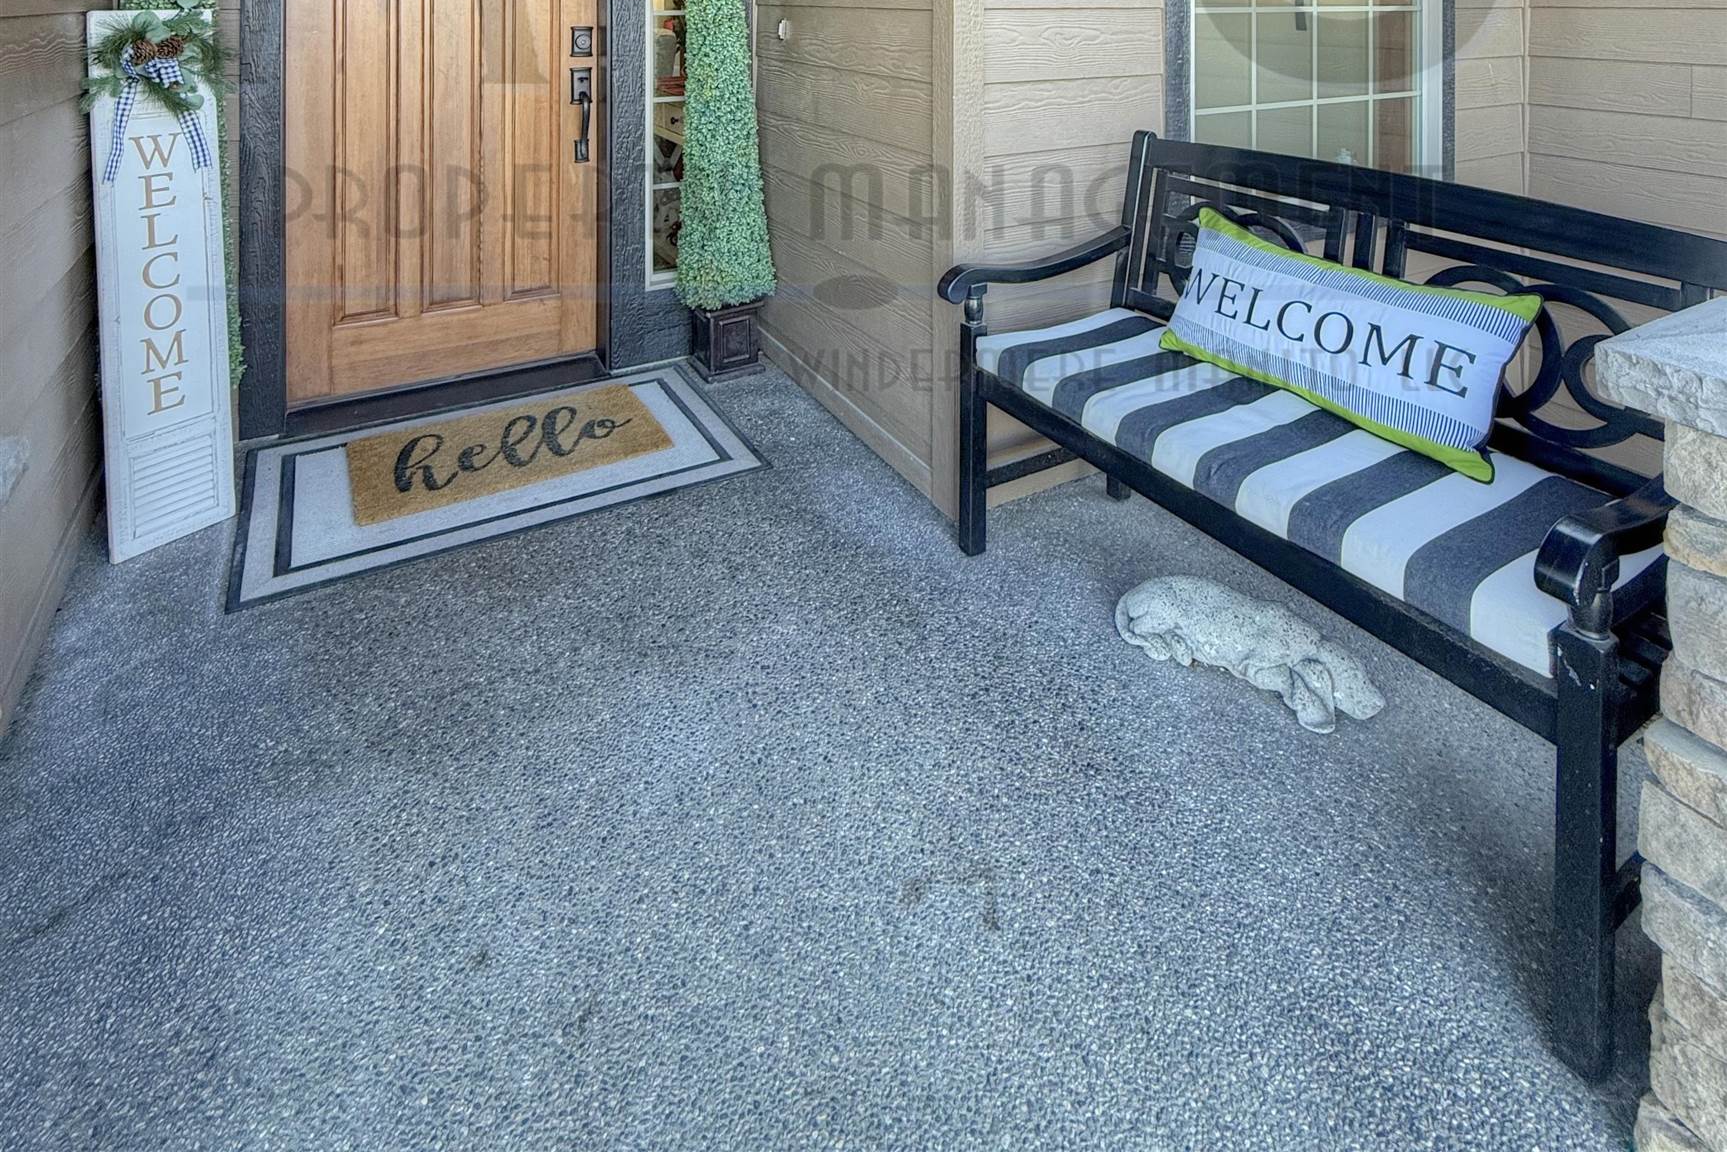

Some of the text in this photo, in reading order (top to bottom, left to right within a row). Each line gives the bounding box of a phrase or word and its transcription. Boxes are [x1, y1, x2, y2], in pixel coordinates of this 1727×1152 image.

[129, 132, 189, 417] WELCOME
[1184, 267, 1477, 399] WELCOME
[393, 405, 633, 493] hello
